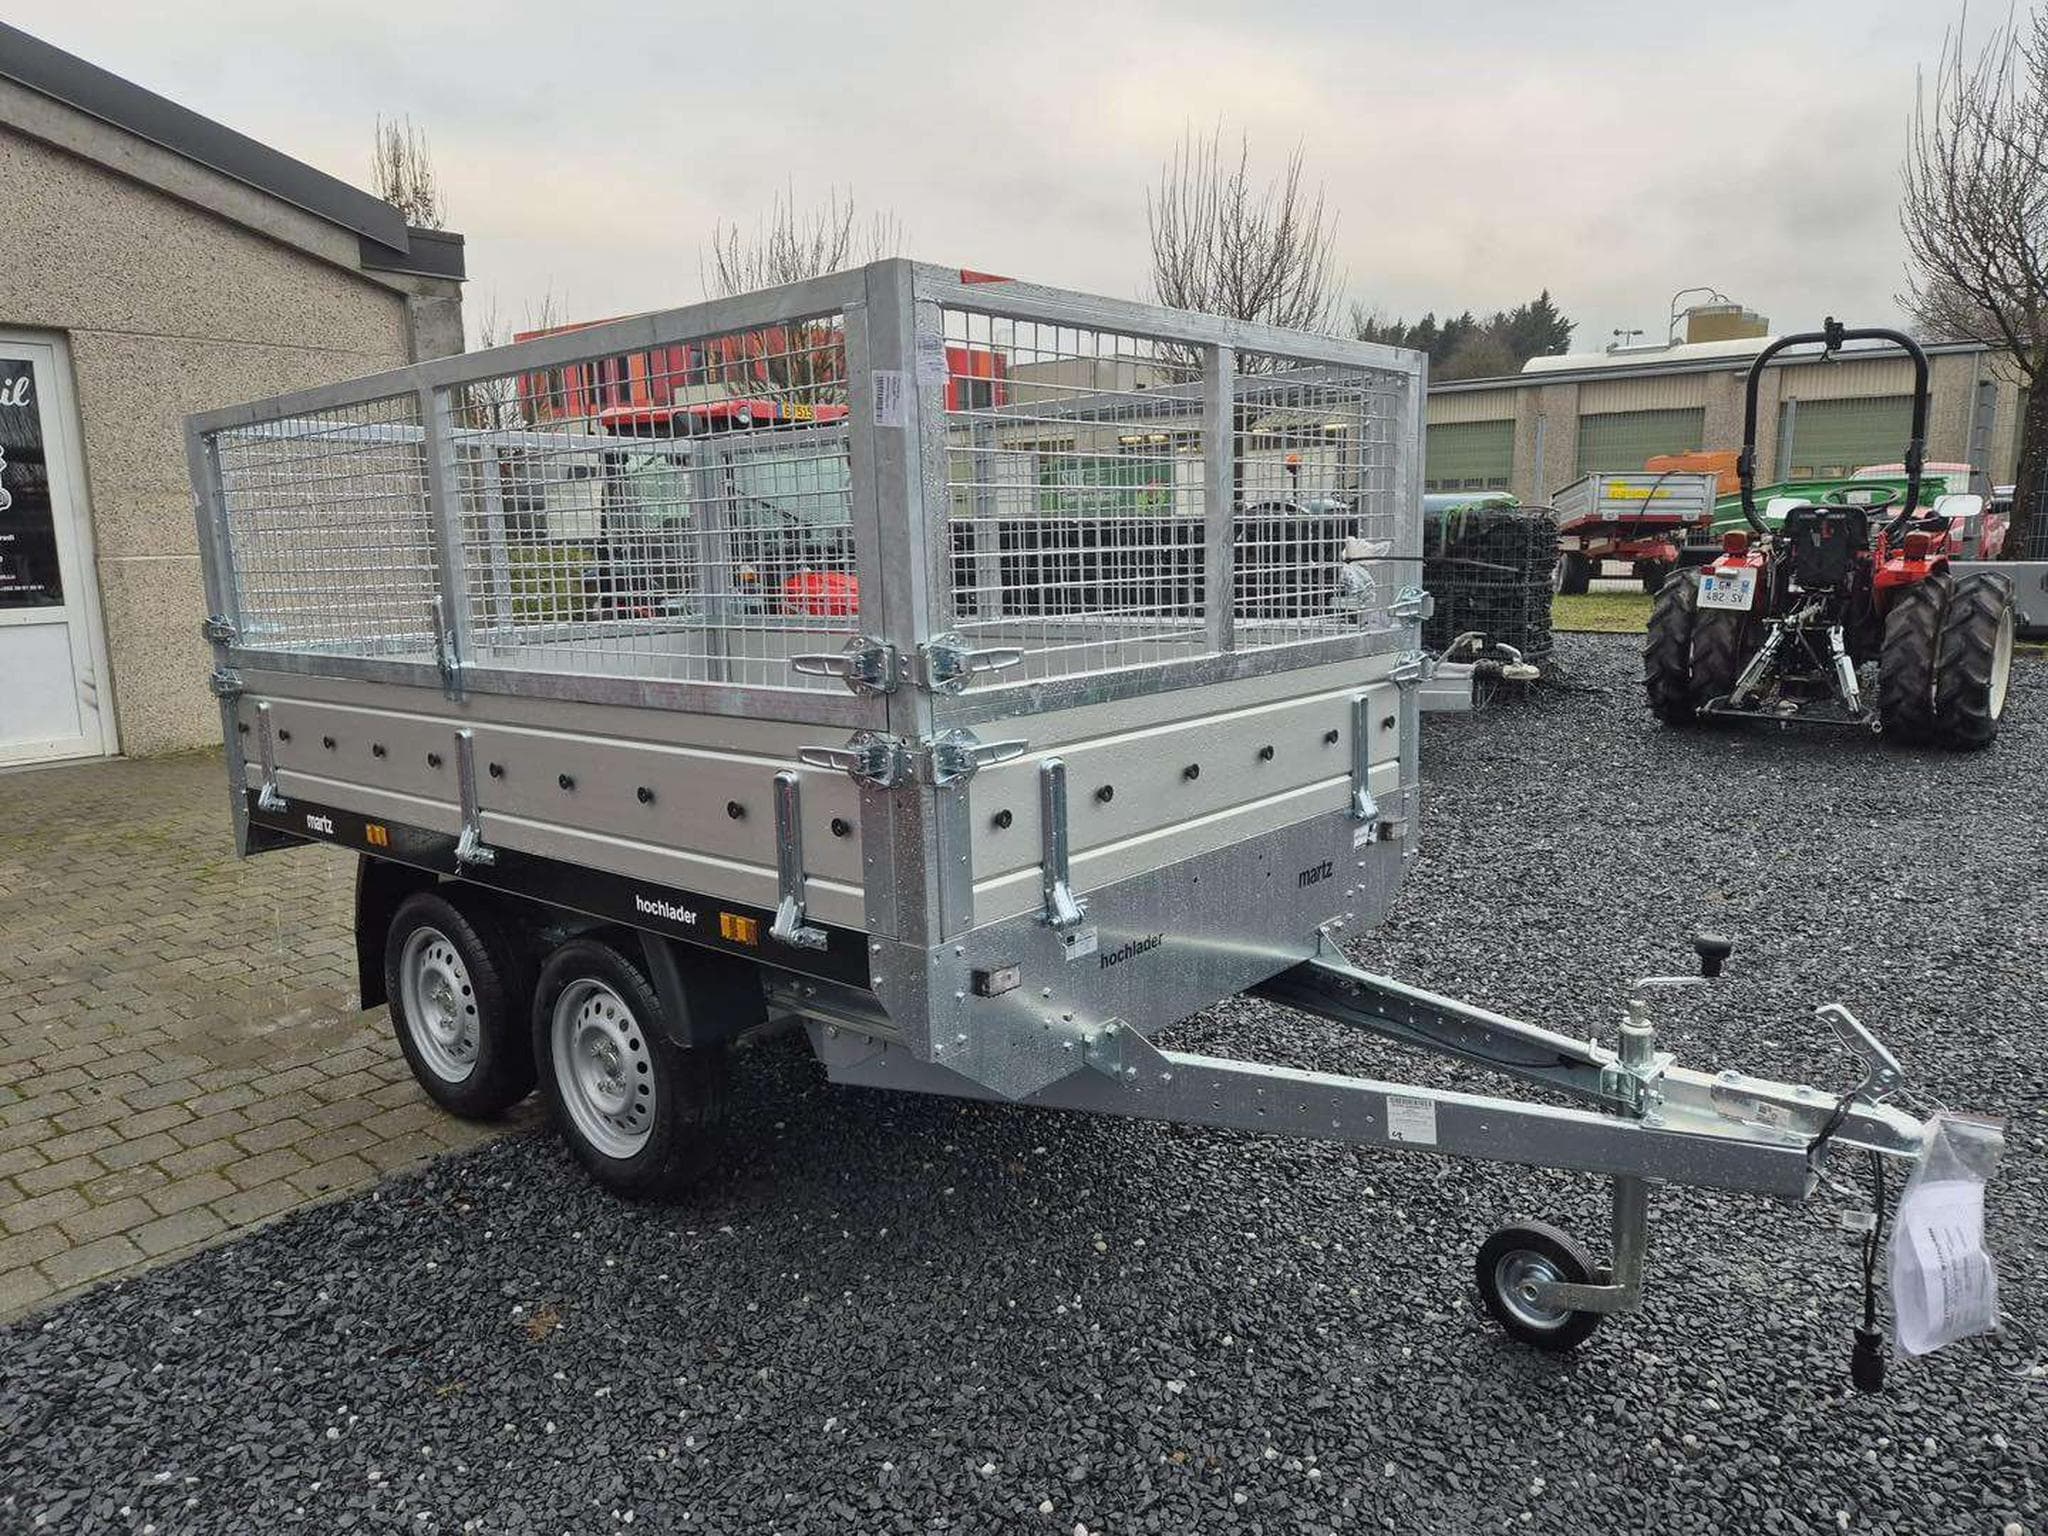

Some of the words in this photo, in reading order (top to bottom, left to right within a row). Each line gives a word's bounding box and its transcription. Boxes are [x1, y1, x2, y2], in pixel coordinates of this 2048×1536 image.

[306, 814, 334, 834] martz
[1299, 860, 1333, 888] martz
[635, 894, 697, 925] hochlader
[1100, 932, 1163, 969] hochlader
